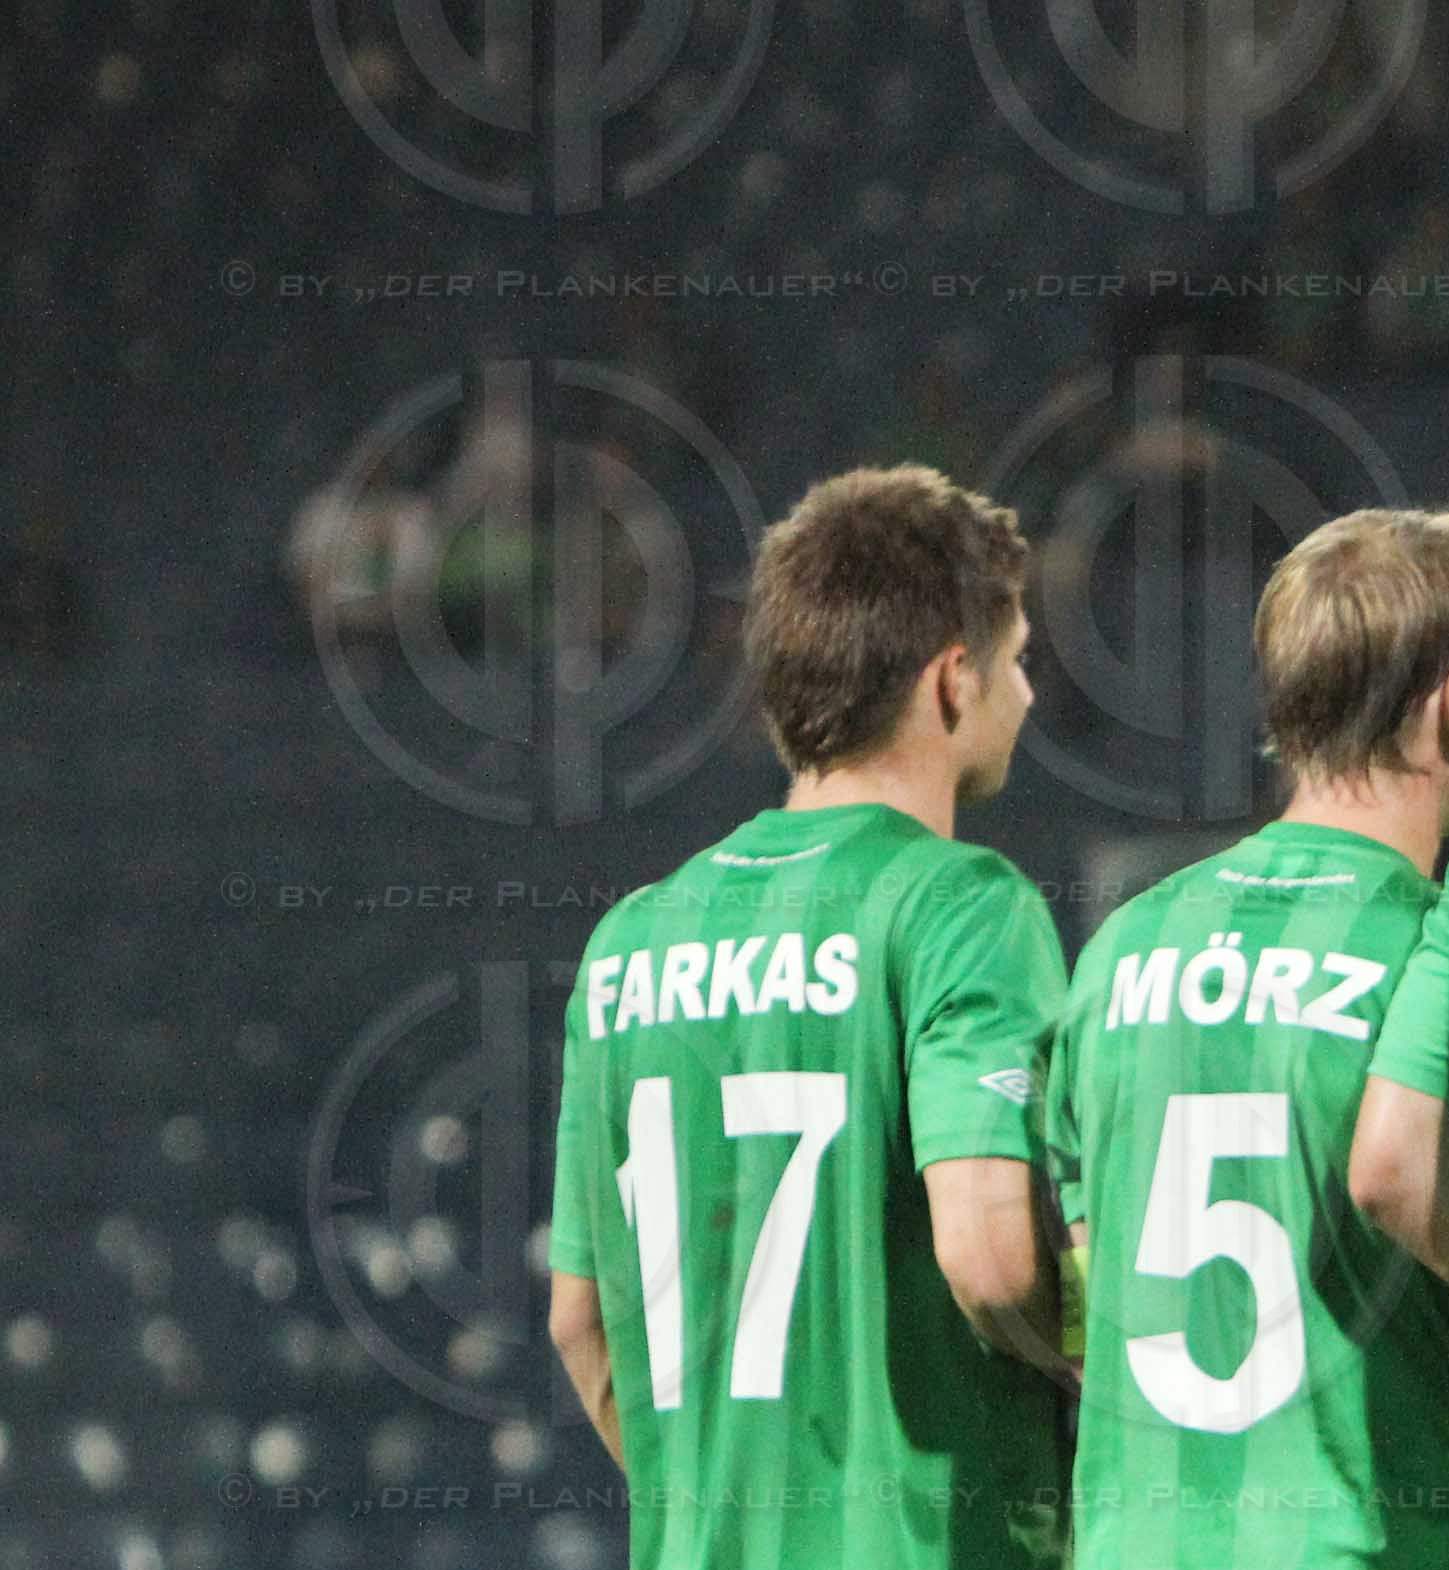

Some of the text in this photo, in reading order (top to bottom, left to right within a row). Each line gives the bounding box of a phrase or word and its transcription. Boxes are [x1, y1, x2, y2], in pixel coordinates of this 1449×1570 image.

[587, 931, 860, 1040] FARKAS
[1105, 930, 1389, 1041] MÖRZ
[615, 1071, 847, 1411] 17
[1126, 1092, 1306, 1434] 5
